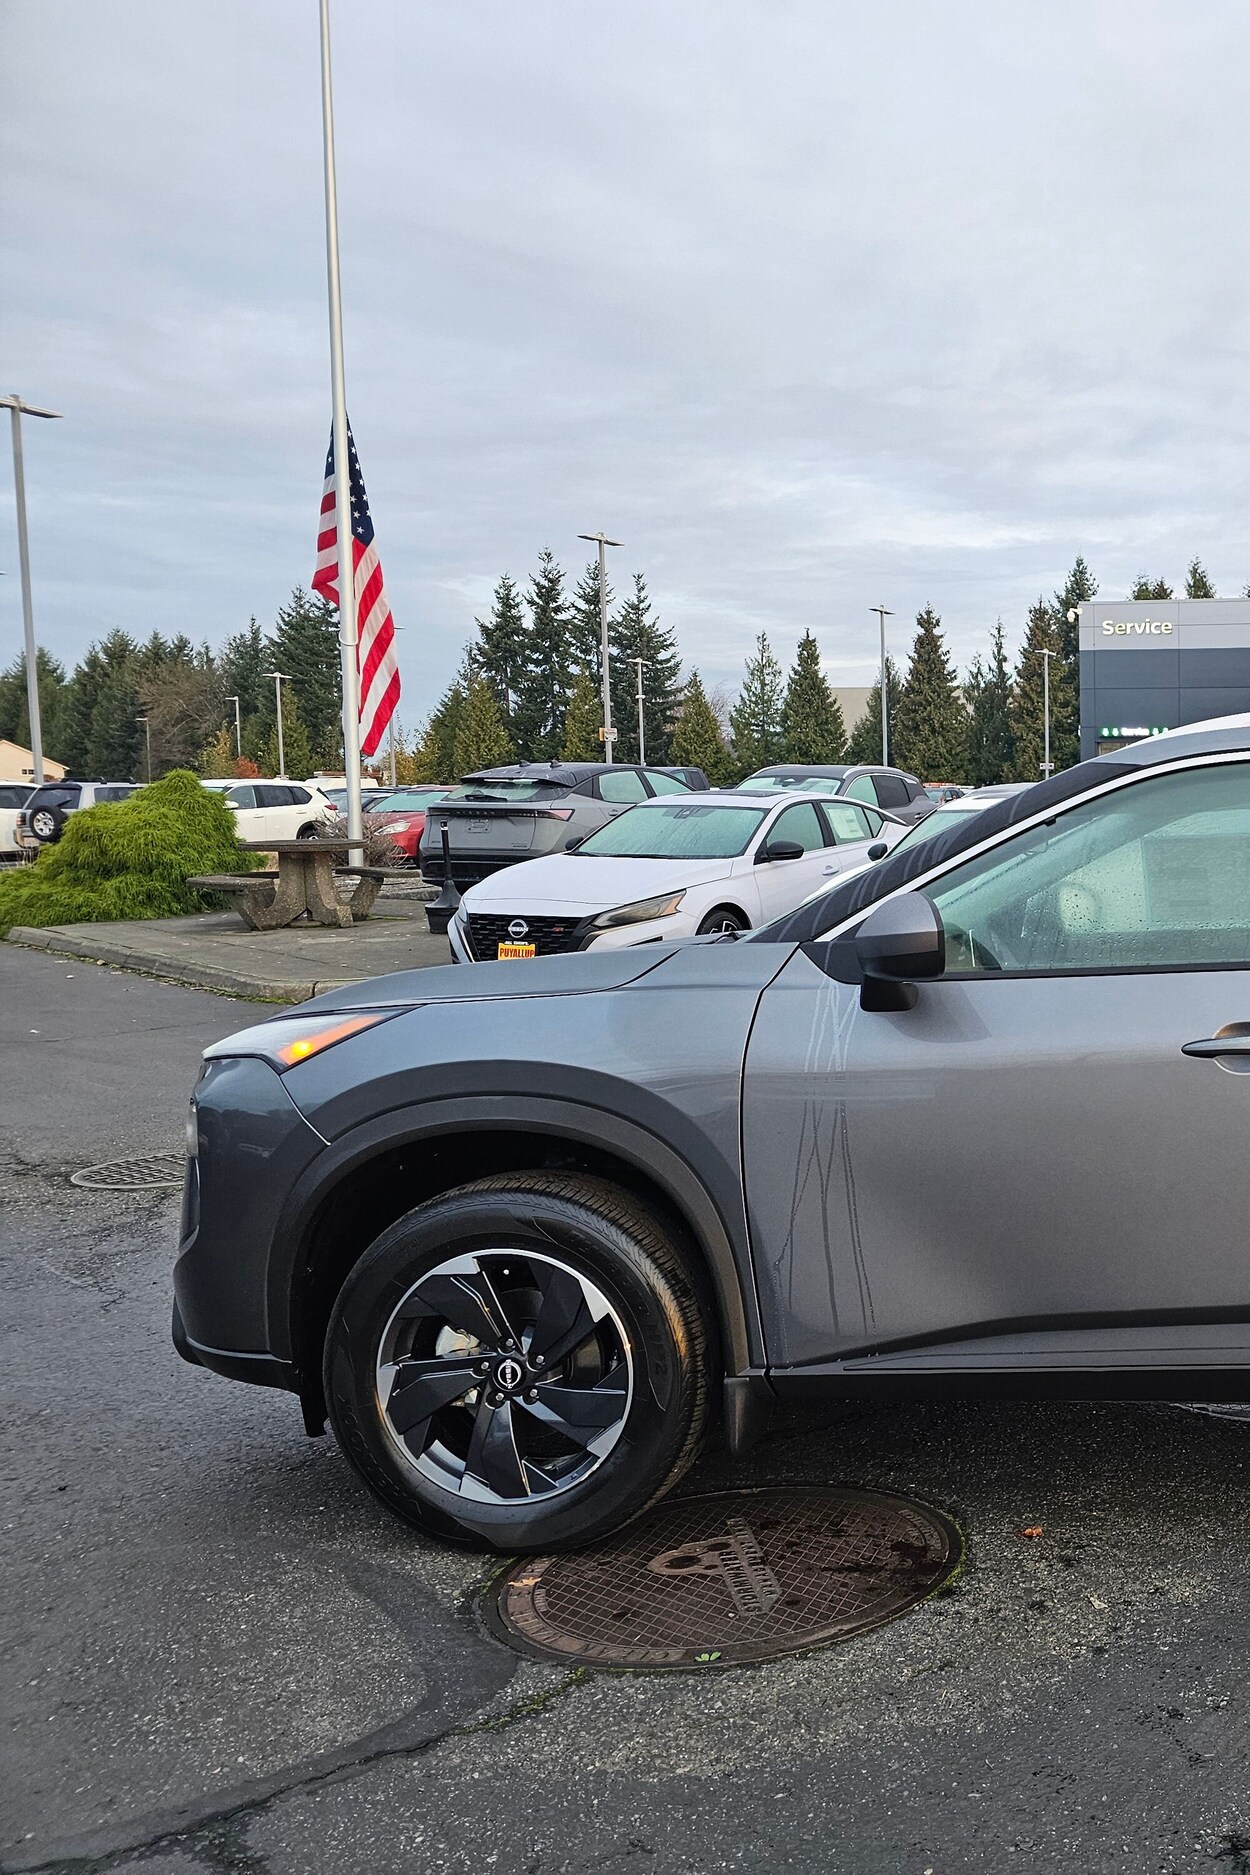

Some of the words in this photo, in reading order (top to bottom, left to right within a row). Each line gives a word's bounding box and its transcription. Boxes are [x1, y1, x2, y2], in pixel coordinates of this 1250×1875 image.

[1102, 619, 1173, 636] Service
[499, 947, 535, 959] PUYALLUP
[718, 1550, 763, 1615] STORMWATER
